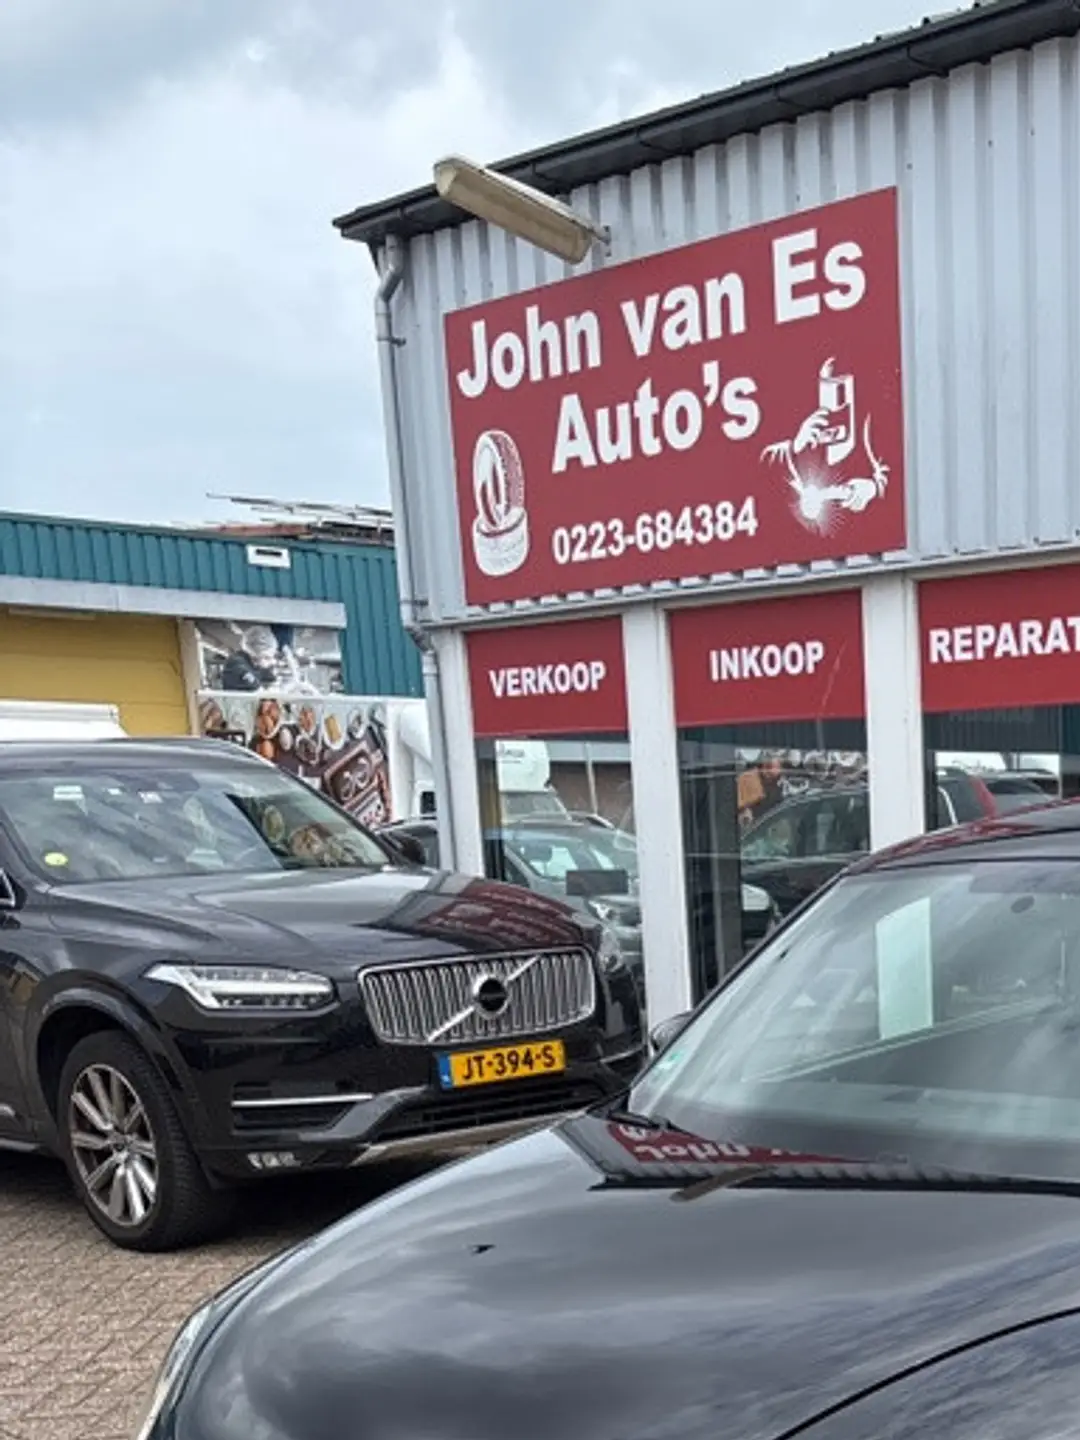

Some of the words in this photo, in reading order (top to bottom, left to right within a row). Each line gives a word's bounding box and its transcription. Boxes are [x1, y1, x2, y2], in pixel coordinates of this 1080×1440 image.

[456, 305, 602, 399] John
[621, 272, 746, 357] van
[772, 228, 866, 324] Es
[551, 360, 761, 474] Auto's
[553, 496, 759, 565] 0223-684384
[489, 660, 606, 699] VERKOOP
[710, 641, 824, 682] INKOOP
[462, 1045, 556, 1080] JT-394-S
